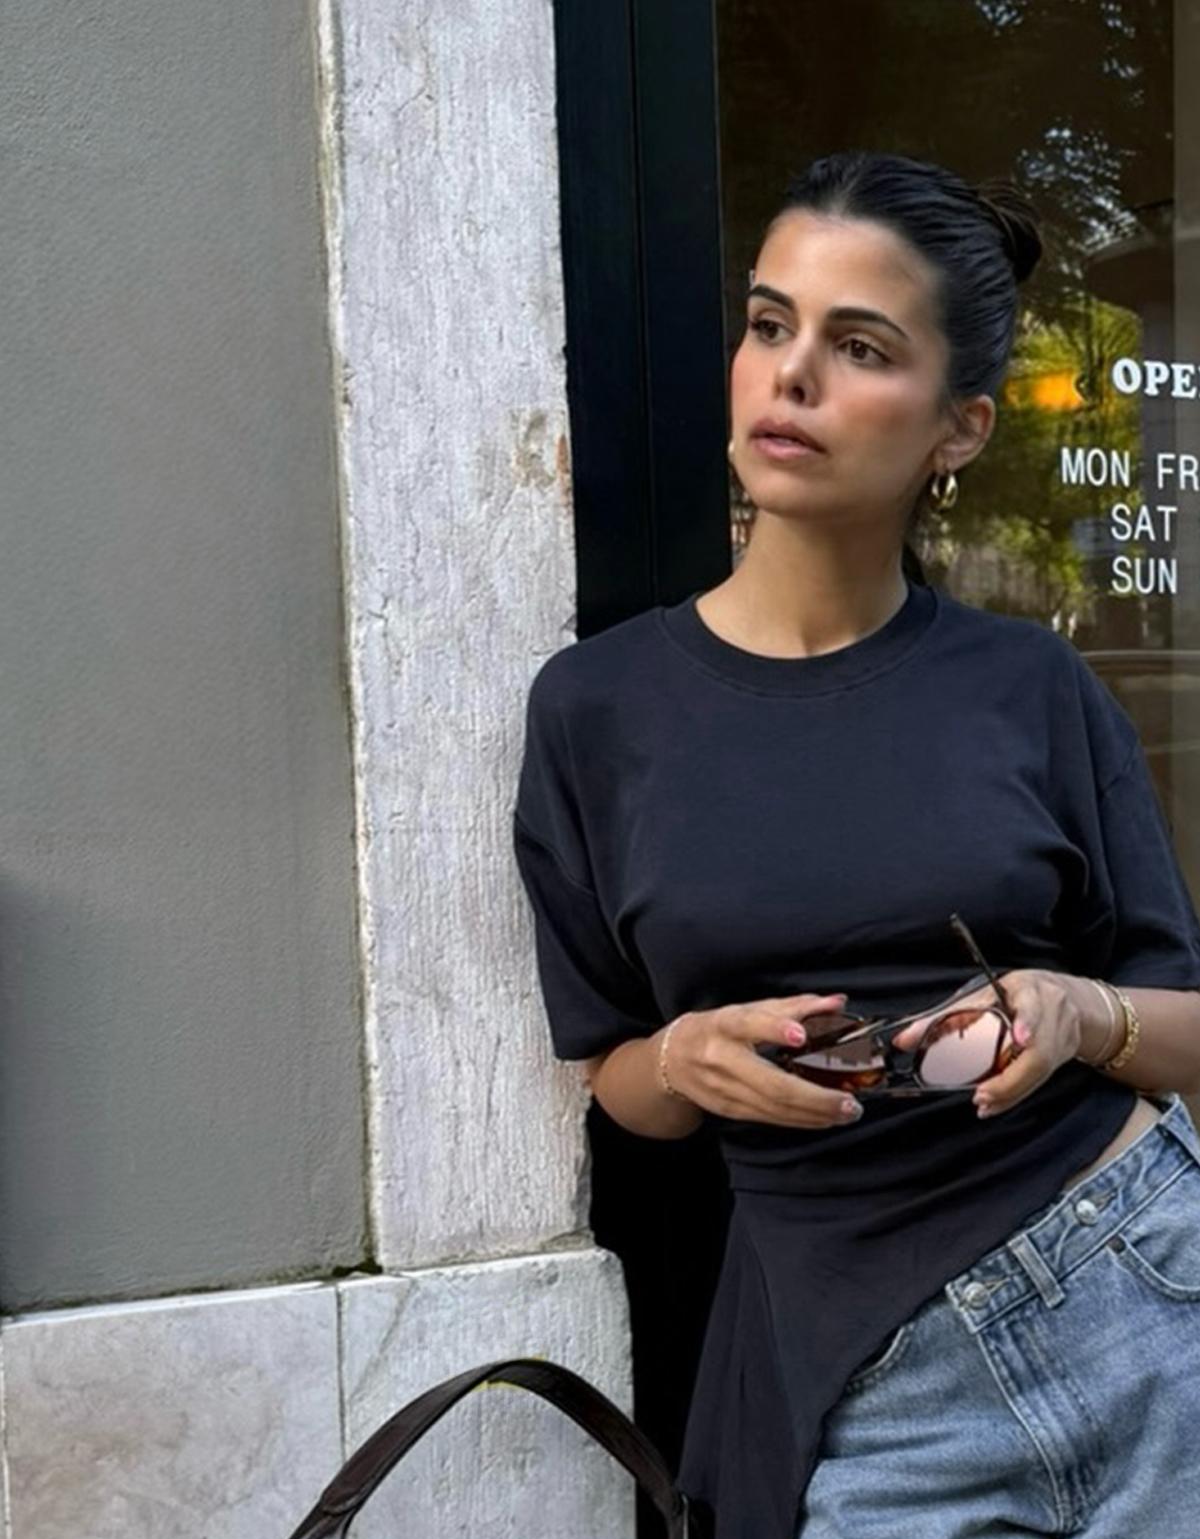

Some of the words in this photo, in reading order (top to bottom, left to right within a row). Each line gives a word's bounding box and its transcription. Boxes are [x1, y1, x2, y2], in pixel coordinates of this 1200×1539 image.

[1061, 447, 1130, 487] MON
[1111, 503, 1178, 542] SAT
[1112, 555, 1177, 594] SUN
